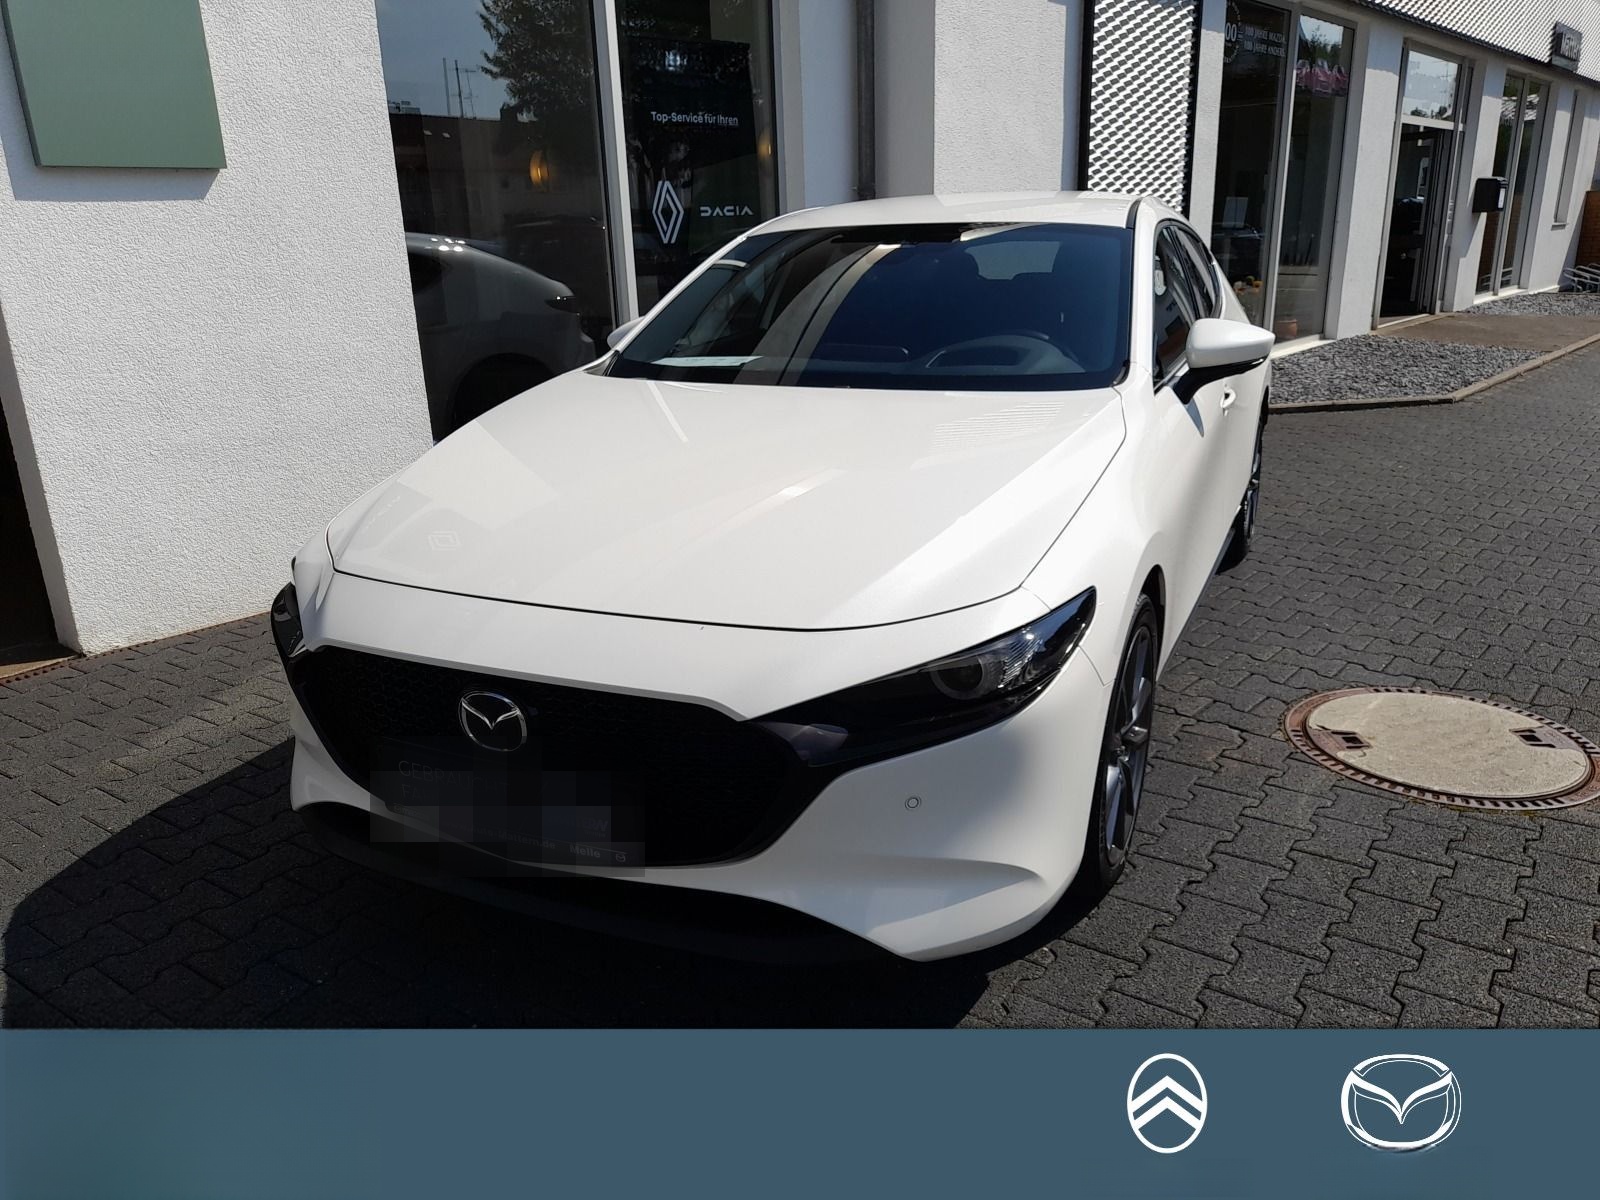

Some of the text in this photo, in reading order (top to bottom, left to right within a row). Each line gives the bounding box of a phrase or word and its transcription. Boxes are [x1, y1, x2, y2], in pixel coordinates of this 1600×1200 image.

[650, 111, 739, 126] Top-Service für Ihren
[700, 205, 754, 217] DACIA
